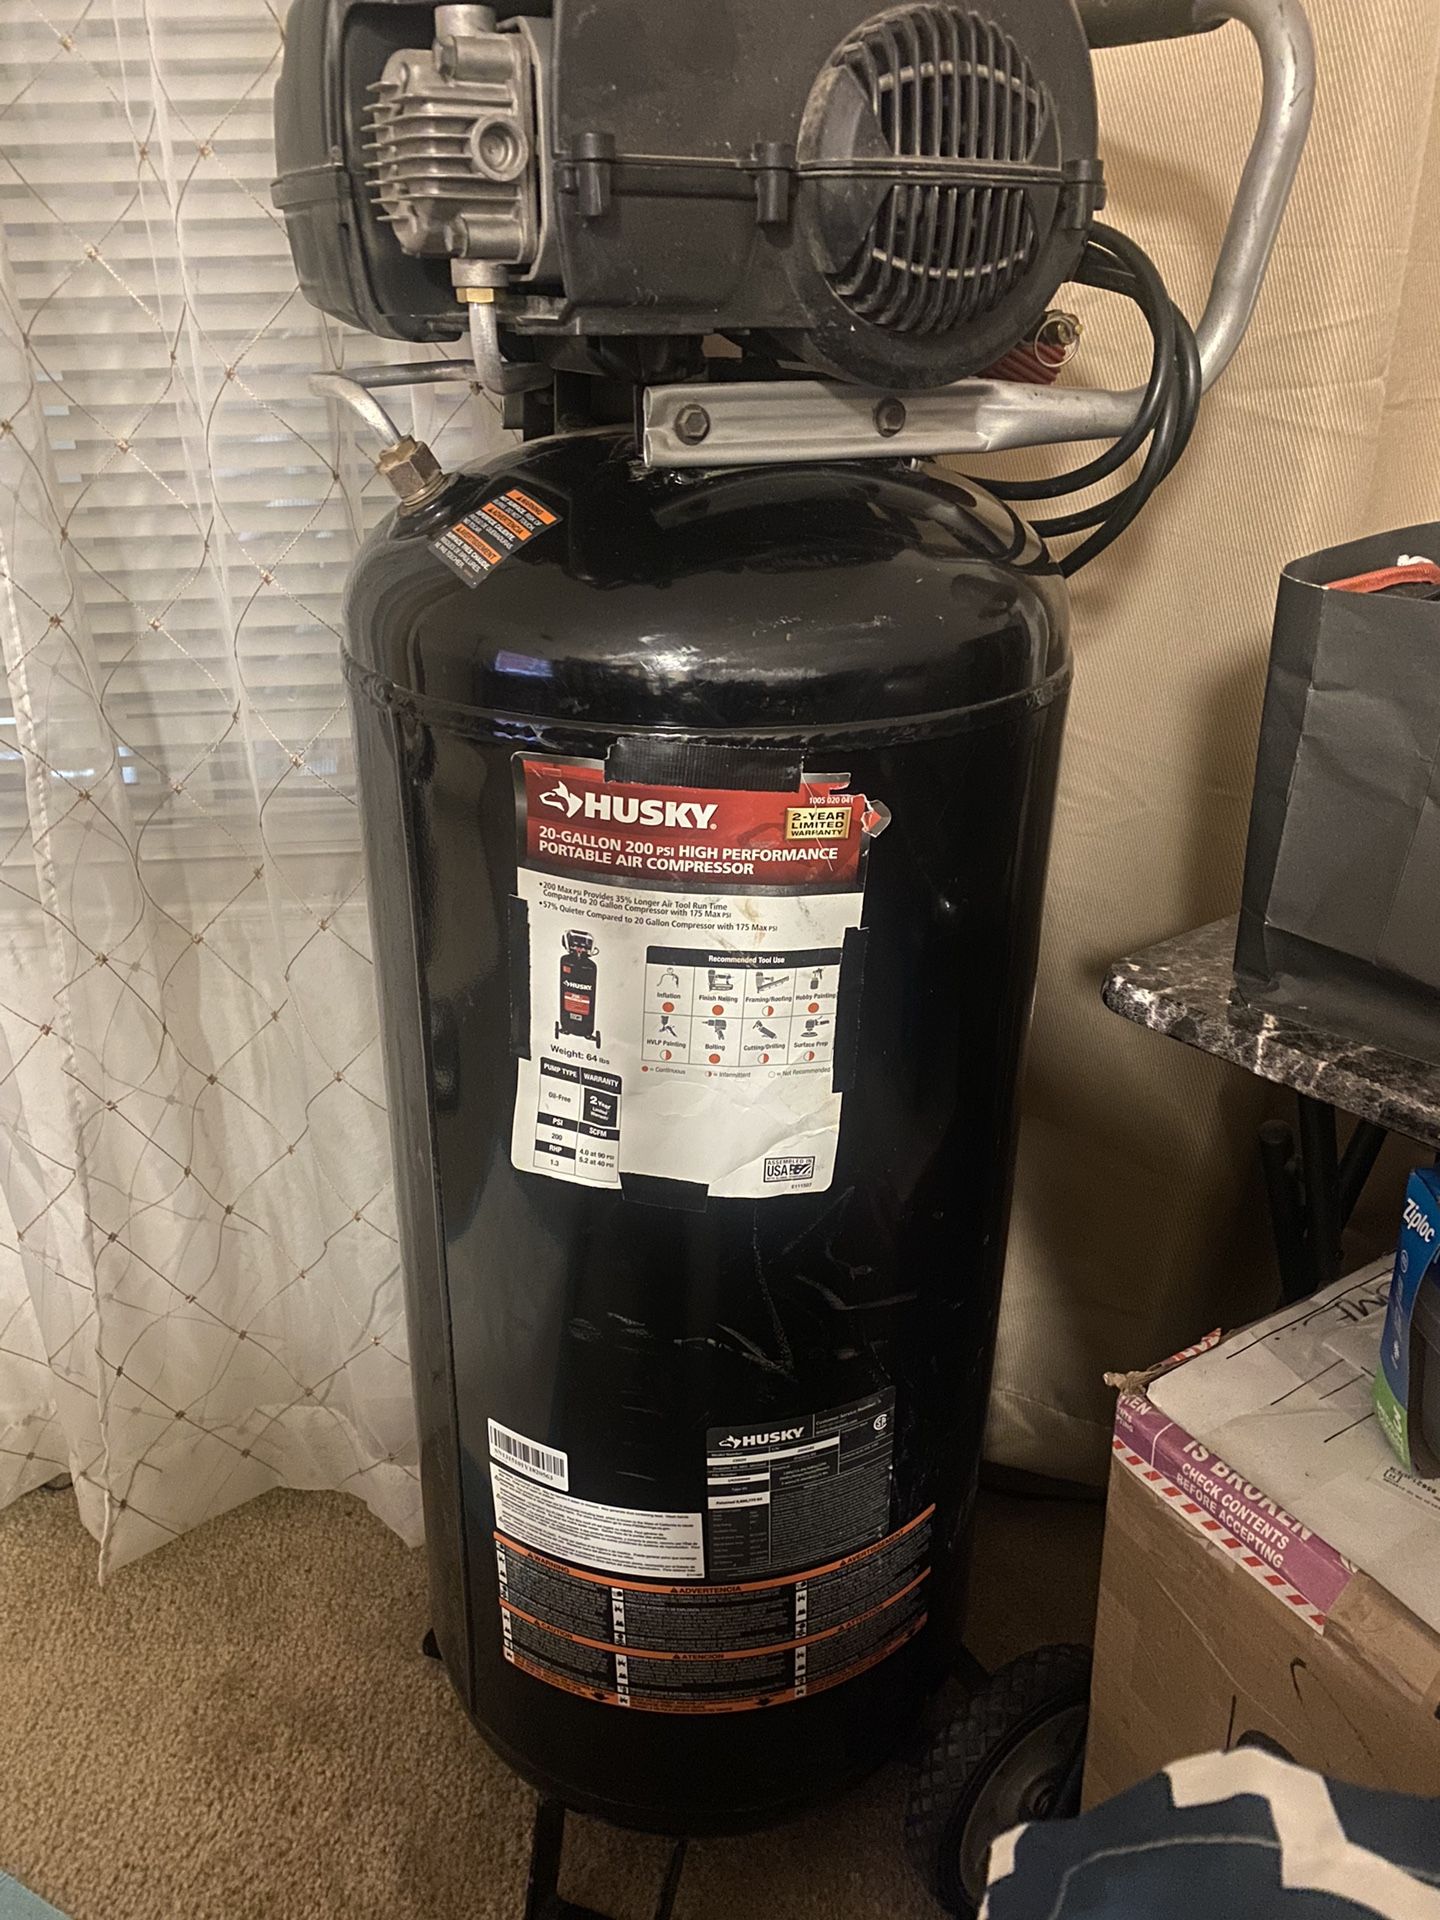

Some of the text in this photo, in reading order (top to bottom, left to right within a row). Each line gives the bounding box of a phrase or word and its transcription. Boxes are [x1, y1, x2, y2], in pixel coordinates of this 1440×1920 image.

[809, 796, 826, 804] 1005
[792, 811, 845, 821] 2-YEAR
[791, 821, 844, 829] LIMITED
[791, 829, 843, 837] WARRANTY
[539, 826, 838, 861] 20-GALLON 200 PSI HIGH PERFORMANCE
[539, 840, 754, 875] PORTABLE AIR COMPRESSOR
[543, 881, 556, 891] 200
[557, 884, 572, 895] Max
[583, 890, 614, 901] Provides
[616, 894, 633, 904] 35%
[634, 898, 660, 909] Longer
[661, 900, 673, 908] Air
[675, 901, 691, 909] Tool
[692, 902, 708, 910] Run
[709, 902, 728, 911] Time
[543, 889, 578, 904] Compared
[579, 896, 587, 904] to
[588, 896, 598, 906] 20
[599, 899, 623, 910] Gallon
[624, 903, 669, 915] Compressor
[670, 908, 688, 917] with
[690, 909, 703, 917] 175
[704, 910, 721, 918] Max
[543, 901, 558, 911] 57%
[559, 904, 585, 916] Quieter
[586, 909, 623, 923] Compared
[634, 916, 644, 924] 20
[645, 918, 670, 927] Gallon
[671, 920, 715, 931] Compressor
[717, 922, 734, 930] with
[736, 923, 750, 931] 175
[751, 924, 768, 932] Max
[708, 954, 786, 964] Recommended Tool Use
[656, 991, 681, 1000] Inflation
[698, 994, 717, 1002] Finish
[795, 991, 836, 1002] Hobby Painting
[662, 1040, 687, 1049] Painting
[704, 1043, 726, 1052] Bolting
[743, 1043, 786, 1052] Cutting/Drilling
[793, 1040, 829, 1049] Surface Prep
[550, 1043, 584, 1060] Weight:
[586, 1052, 598, 1063] 64
[543, 1062, 577, 1078] PUMP TYPE
[583, 1073, 619, 1088] WARRANTY
[548, 1091, 572, 1103] Oil-Free
[589, 1095, 612, 1109] 2 Year
[552, 1117, 564, 1126] PSI
[551, 1133, 563, 1141] 200
[588, 1127, 607, 1137] SCFM
[549, 1144, 563, 1153] RHP
[767, 1164, 788, 1177] USA
[1402, 1198, 1435, 1244] Ziploc
[742, 1427, 804, 1447] HUSKY
[1181, 1461, 1291, 1550] CHECK CONTENTS
[1175, 1472, 1285, 1569] BEFORE ACCEPTING
[533, 1554, 570, 1574] WARNING
[679, 1585, 742, 1594] ADVERTENCIA
[541, 1621, 573, 1639] CAUTION
